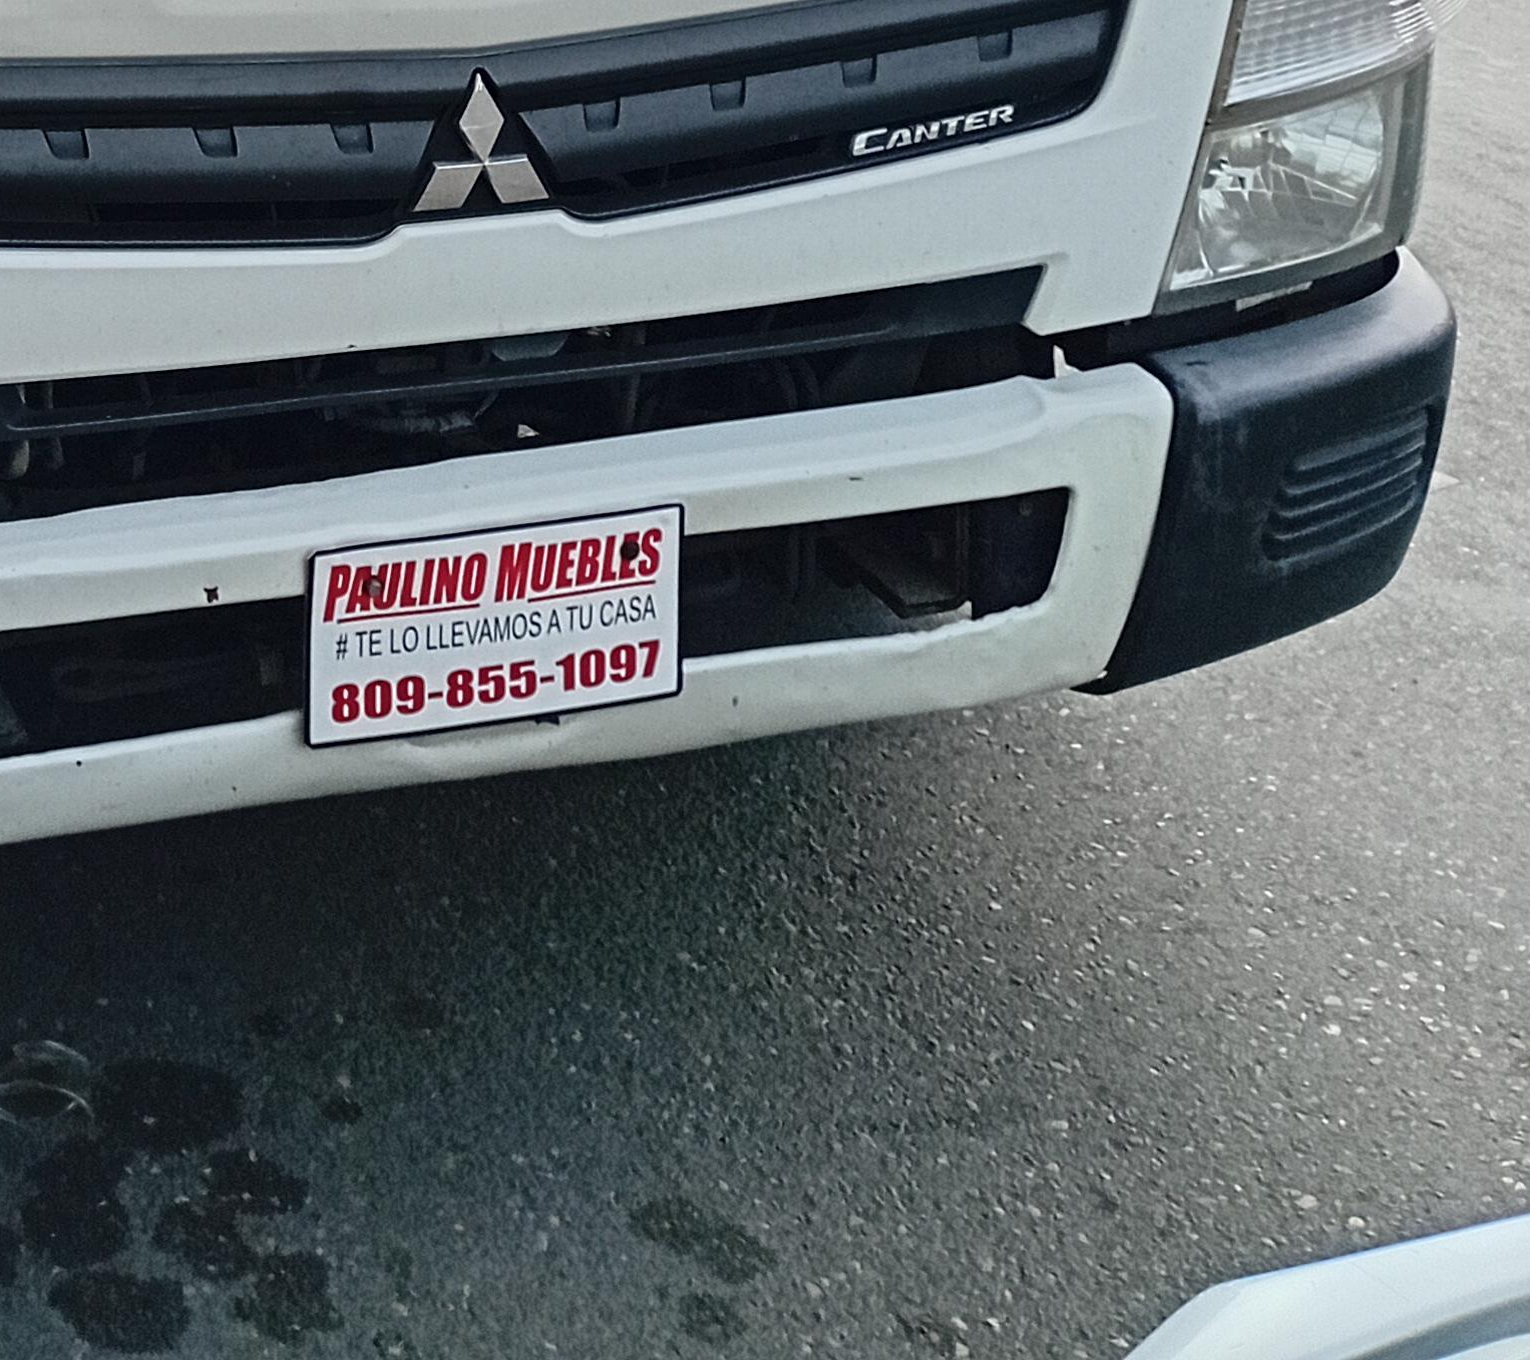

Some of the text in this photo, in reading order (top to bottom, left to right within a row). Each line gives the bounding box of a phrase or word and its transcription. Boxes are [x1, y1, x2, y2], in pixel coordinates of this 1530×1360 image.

[852, 104, 1015, 157] CANTER
[322, 527, 663, 623] PAULINO MUEBLES
[356, 628, 382, 658] TE
[390, 624, 419, 654] LO
[426, 611, 543, 651] LLEVAMOS
[546, 607, 563, 635] A
[566, 604, 593, 632] TU
[599, 594, 657, 628] CASA
[330, 639, 662, 724] 809-855-1097
